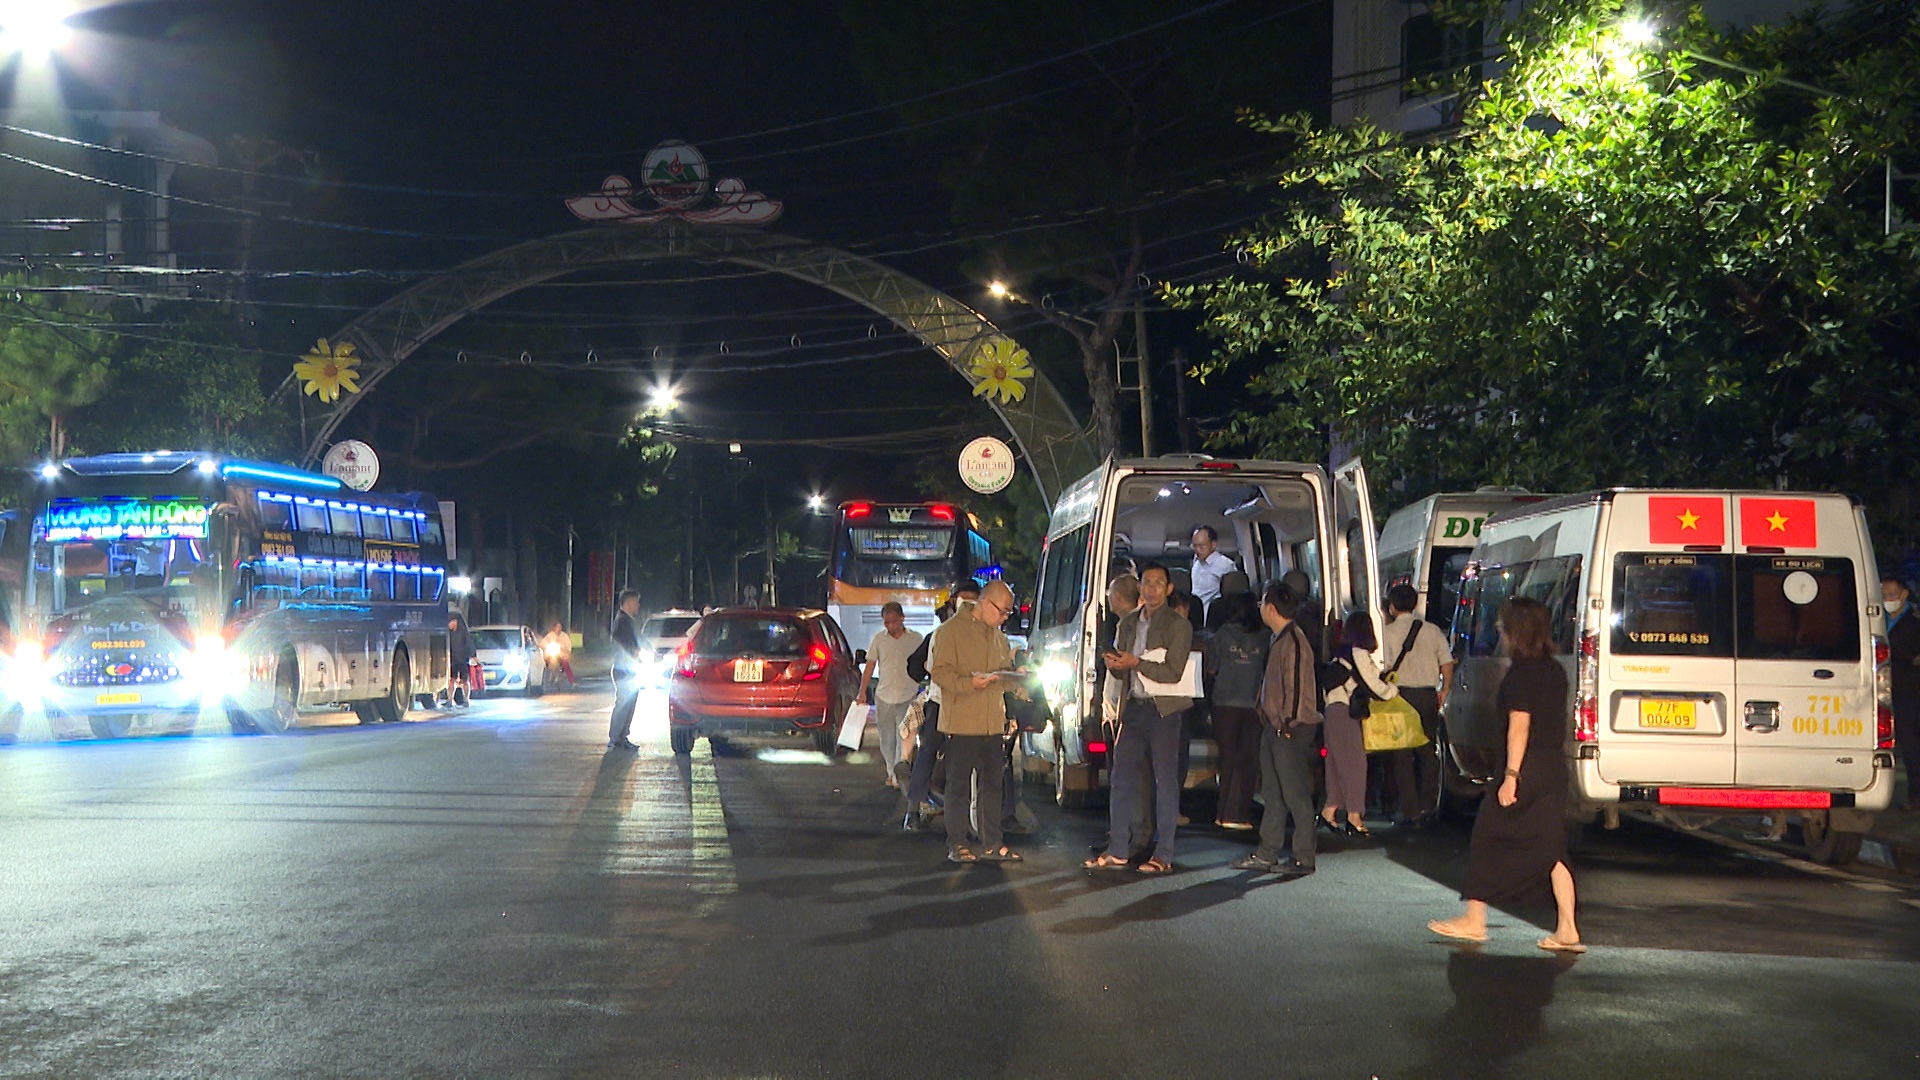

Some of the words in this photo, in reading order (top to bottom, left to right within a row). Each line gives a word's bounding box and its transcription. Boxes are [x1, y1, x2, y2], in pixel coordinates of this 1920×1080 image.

[1641, 633, 1666, 642] 0973
[1656, 701, 1680, 713] 77F
[1807, 695, 1847, 714] 77F
[1792, 716, 1863, 736] 004.09
